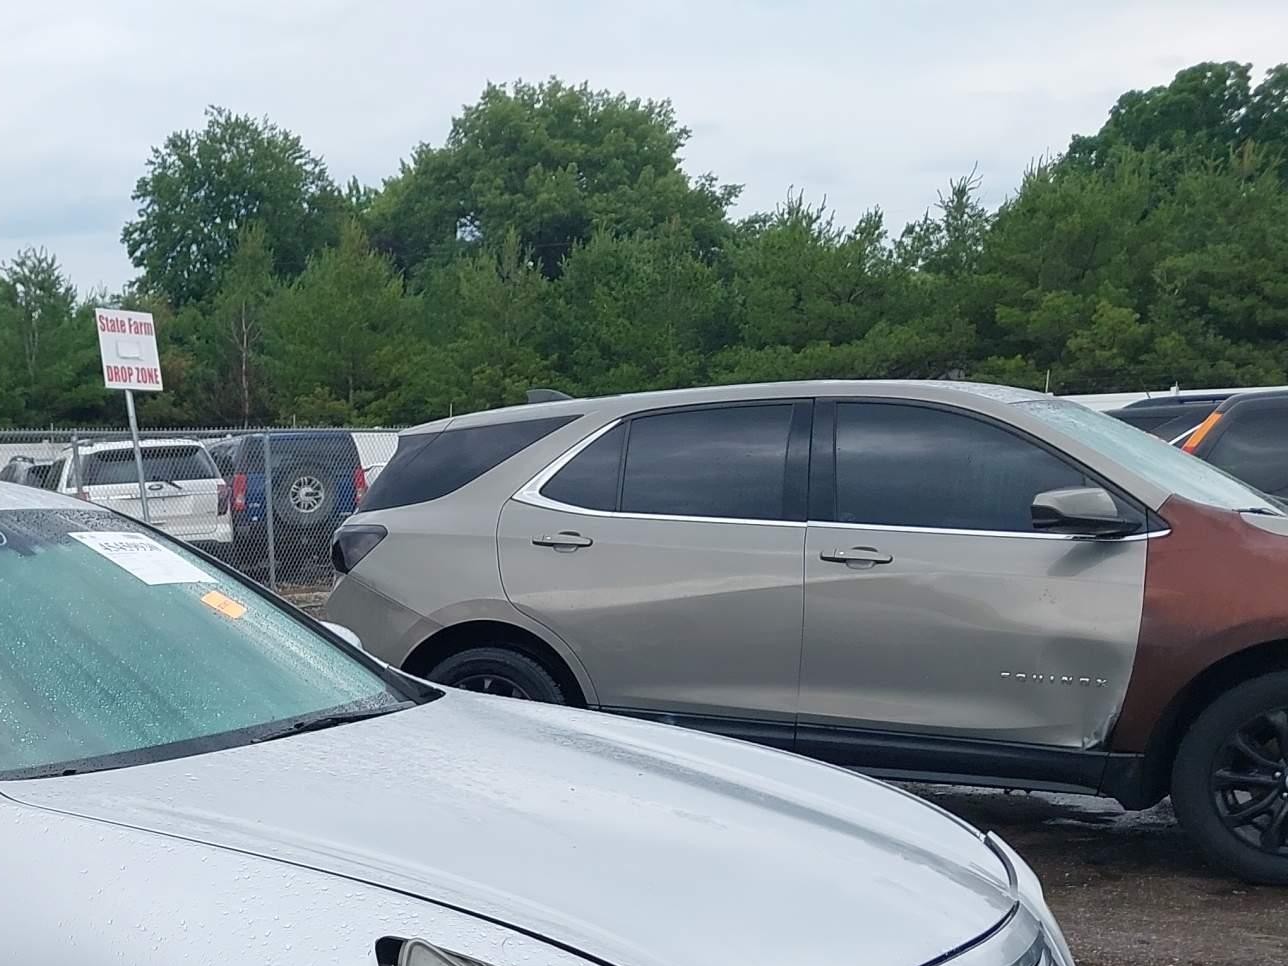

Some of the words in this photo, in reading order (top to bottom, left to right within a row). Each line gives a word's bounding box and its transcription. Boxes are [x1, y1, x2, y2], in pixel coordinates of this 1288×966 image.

[99, 315, 126, 333] State
[128, 318, 153, 336] Farm
[106, 365, 133, 383] DROP
[136, 367, 159, 384] ZONE
